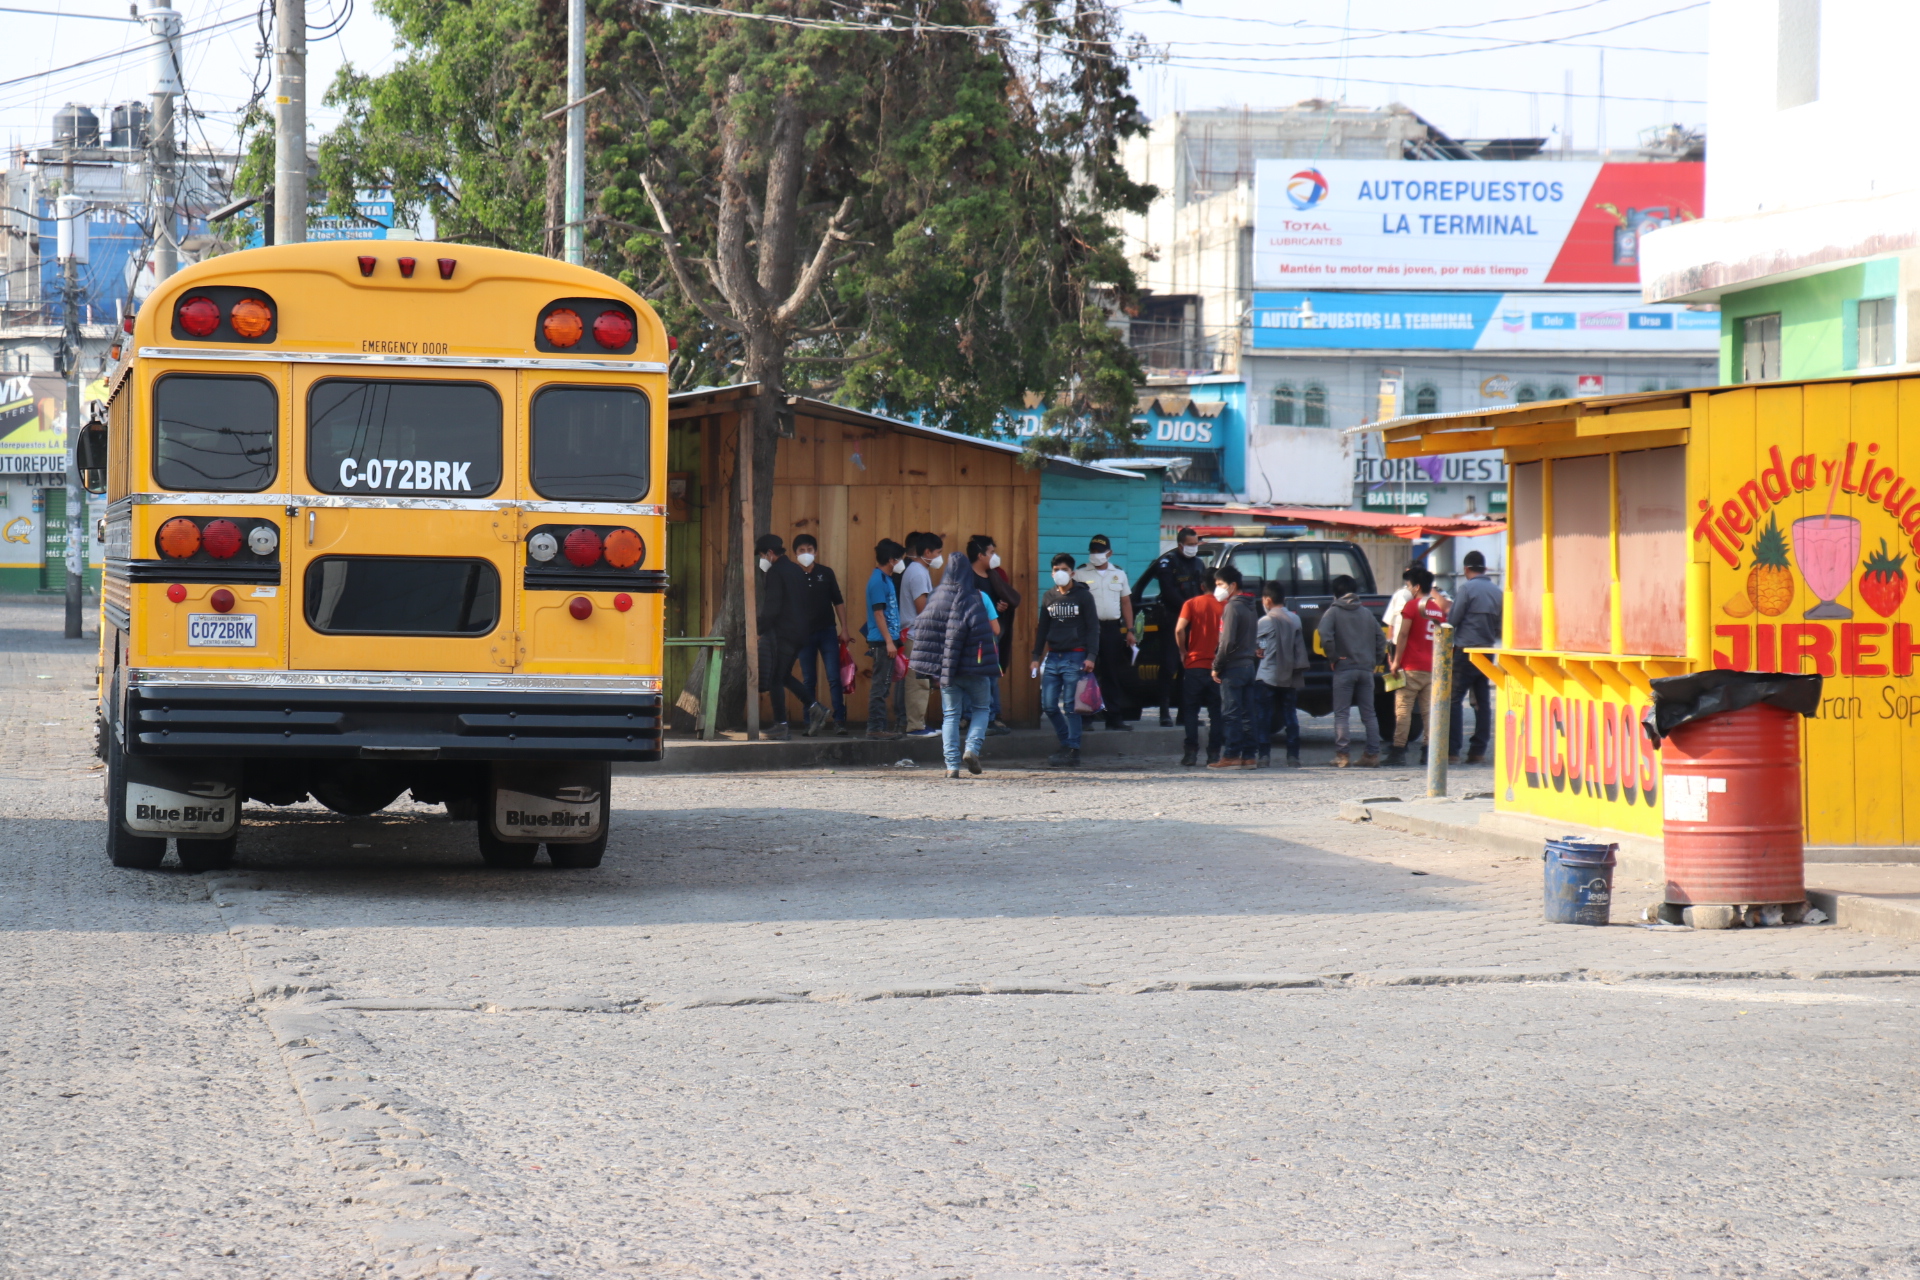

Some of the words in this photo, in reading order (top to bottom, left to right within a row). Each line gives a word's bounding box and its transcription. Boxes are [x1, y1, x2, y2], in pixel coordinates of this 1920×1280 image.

[1358, 180, 1564, 201] AUTOREPUESTOS
[1282, 220, 1332, 231] TOTAL
[1382, 213, 1411, 235] LA
[1419, 214, 1538, 235] TERMINAL
[1270, 238, 1342, 246] LUBRICANTES
[1280, 263, 1322, 275] Mantén
[1325, 264, 1336, 275] tu
[1340, 264, 1373, 275] motor
[1377, 263, 1400, 275] más
[1403, 264, 1437, 276] joven,
[1440, 266, 1461, 277] por
[1464, 264, 1487, 276] más
[1490, 264, 1528, 277] tiempo
[1261, 312, 1299, 328] AUTO
[1302, 313, 1381, 329] EPUESTOS
[1384, 313, 1401, 329] LA
[1404, 313, 1474, 329] TERMINAL
[1543, 315, 1563, 326] Delo
[1640, 314, 1661, 327] Ursa
[362, 340, 418, 353] EMERGENCY
[422, 343, 448, 354] DOOR
[1157, 420, 1212, 443] DIOS
[340, 458, 472, 491] C-072BRK
[1367, 493, 1429, 505] BATERIAS
[1693, 444, 1818, 571] Tienda
[1821, 459, 1838, 485] Y
[1525, 694, 1658, 802] LICUADOS
[136, 804, 180, 820] Blue
[183, 806, 225, 822] Bird
[506, 810, 548, 826] Blue
[551, 811, 590, 826] Bird
